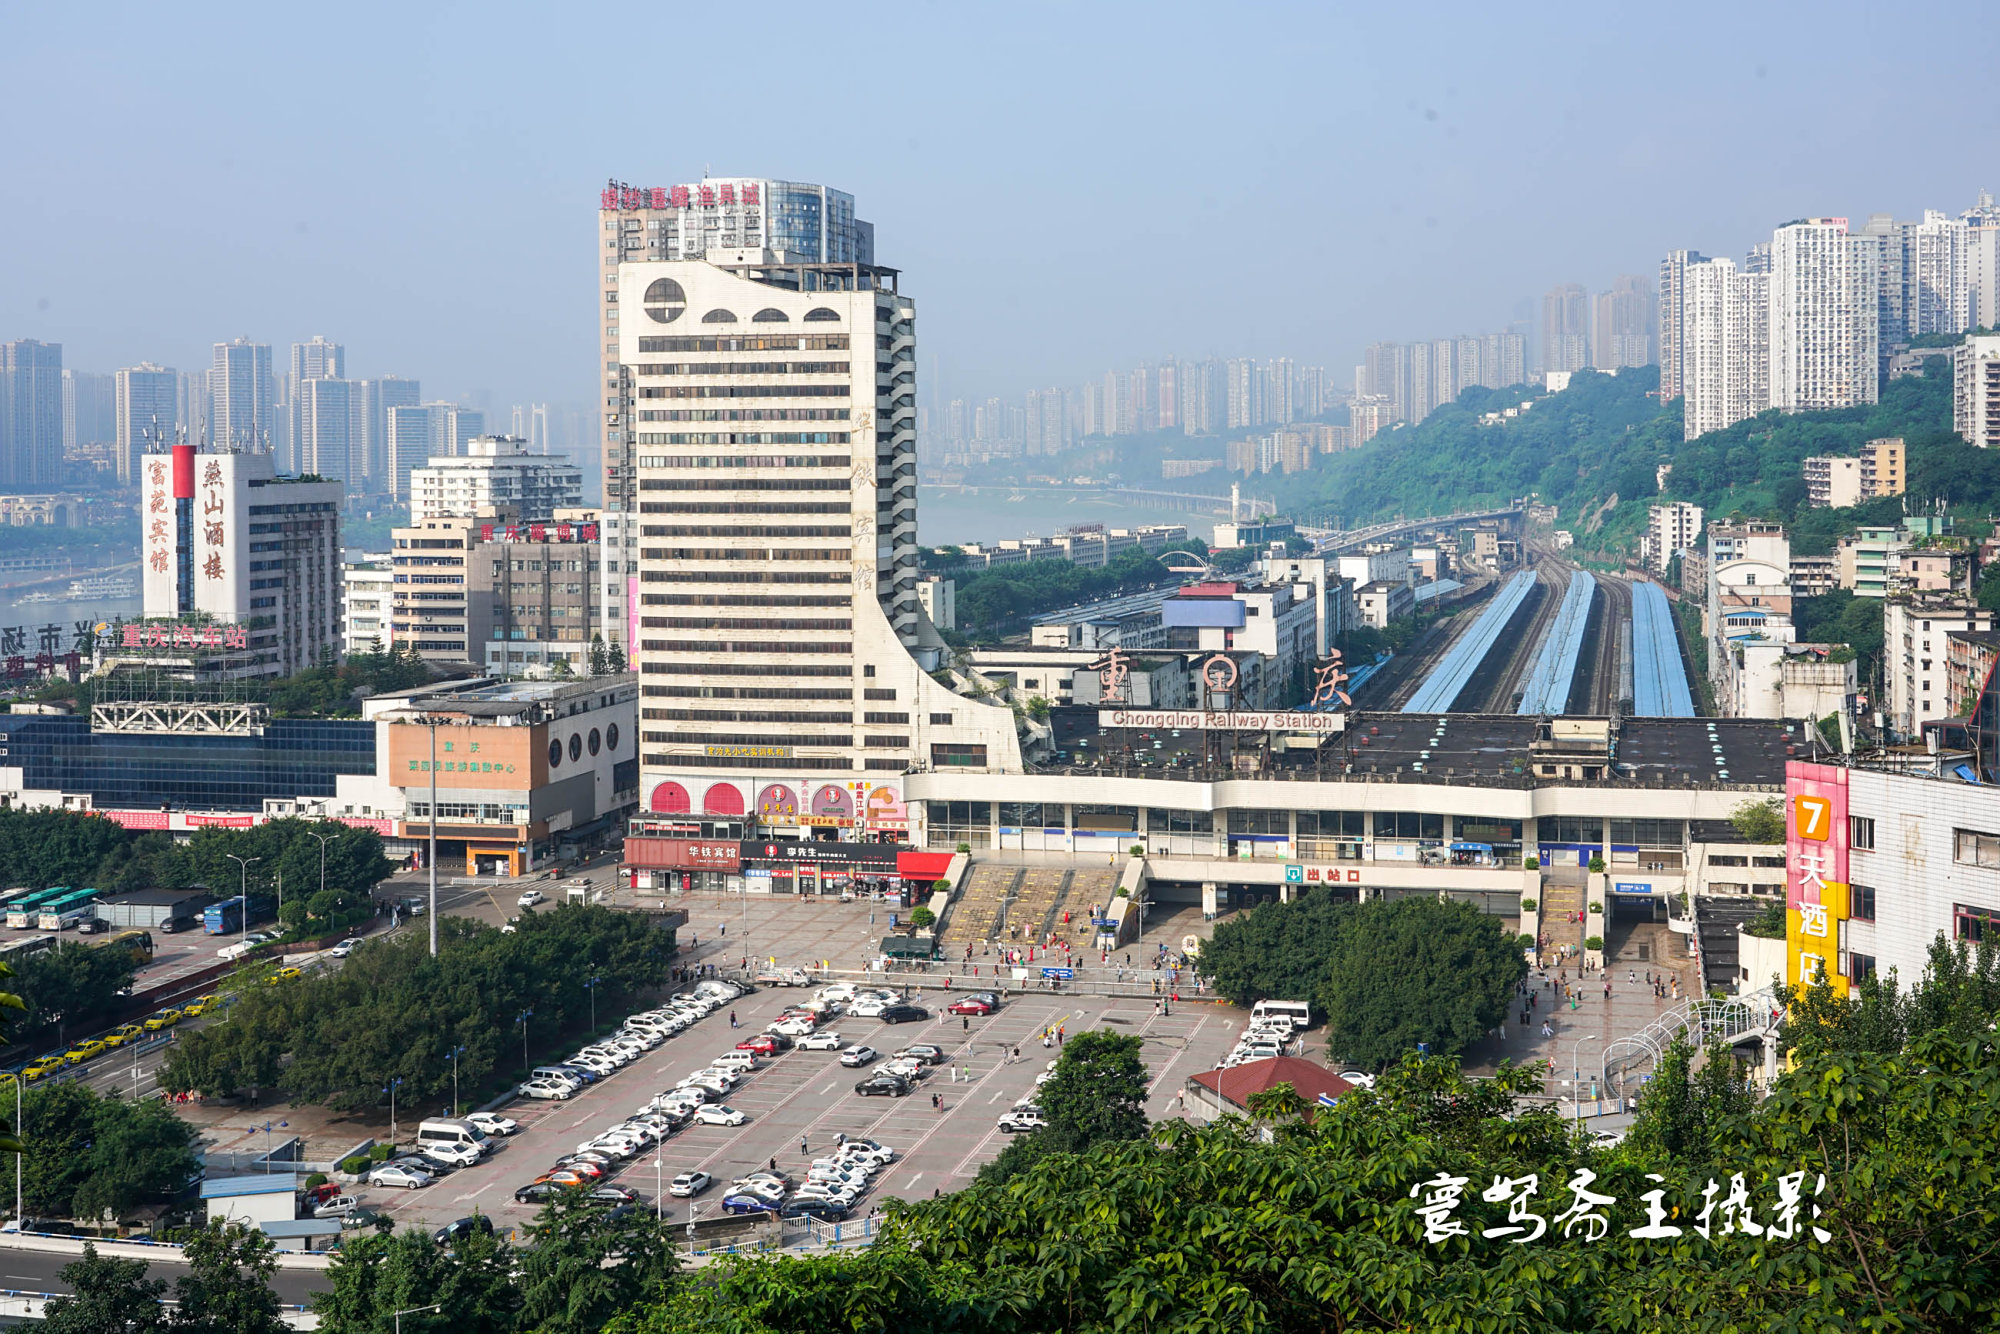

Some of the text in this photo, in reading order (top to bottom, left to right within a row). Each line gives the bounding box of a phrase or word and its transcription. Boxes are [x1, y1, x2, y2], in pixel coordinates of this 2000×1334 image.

[600, 183, 761, 210] 婚纱喜糖渔具城
[148, 459, 169, 574] 富苑宾馆
[202, 459, 225, 581] 燕山酒楼
[121, 624, 247, 649] 重庆汽车站
[1088, 646, 1352, 706] 重 庆
[1112, 710, 1332, 730] Chongqing Railway Station
[688, 846, 736, 858] 华铁宾馆
[787, 847, 817, 857] 李先生
[1307, 868, 1360, 882] 出站口
